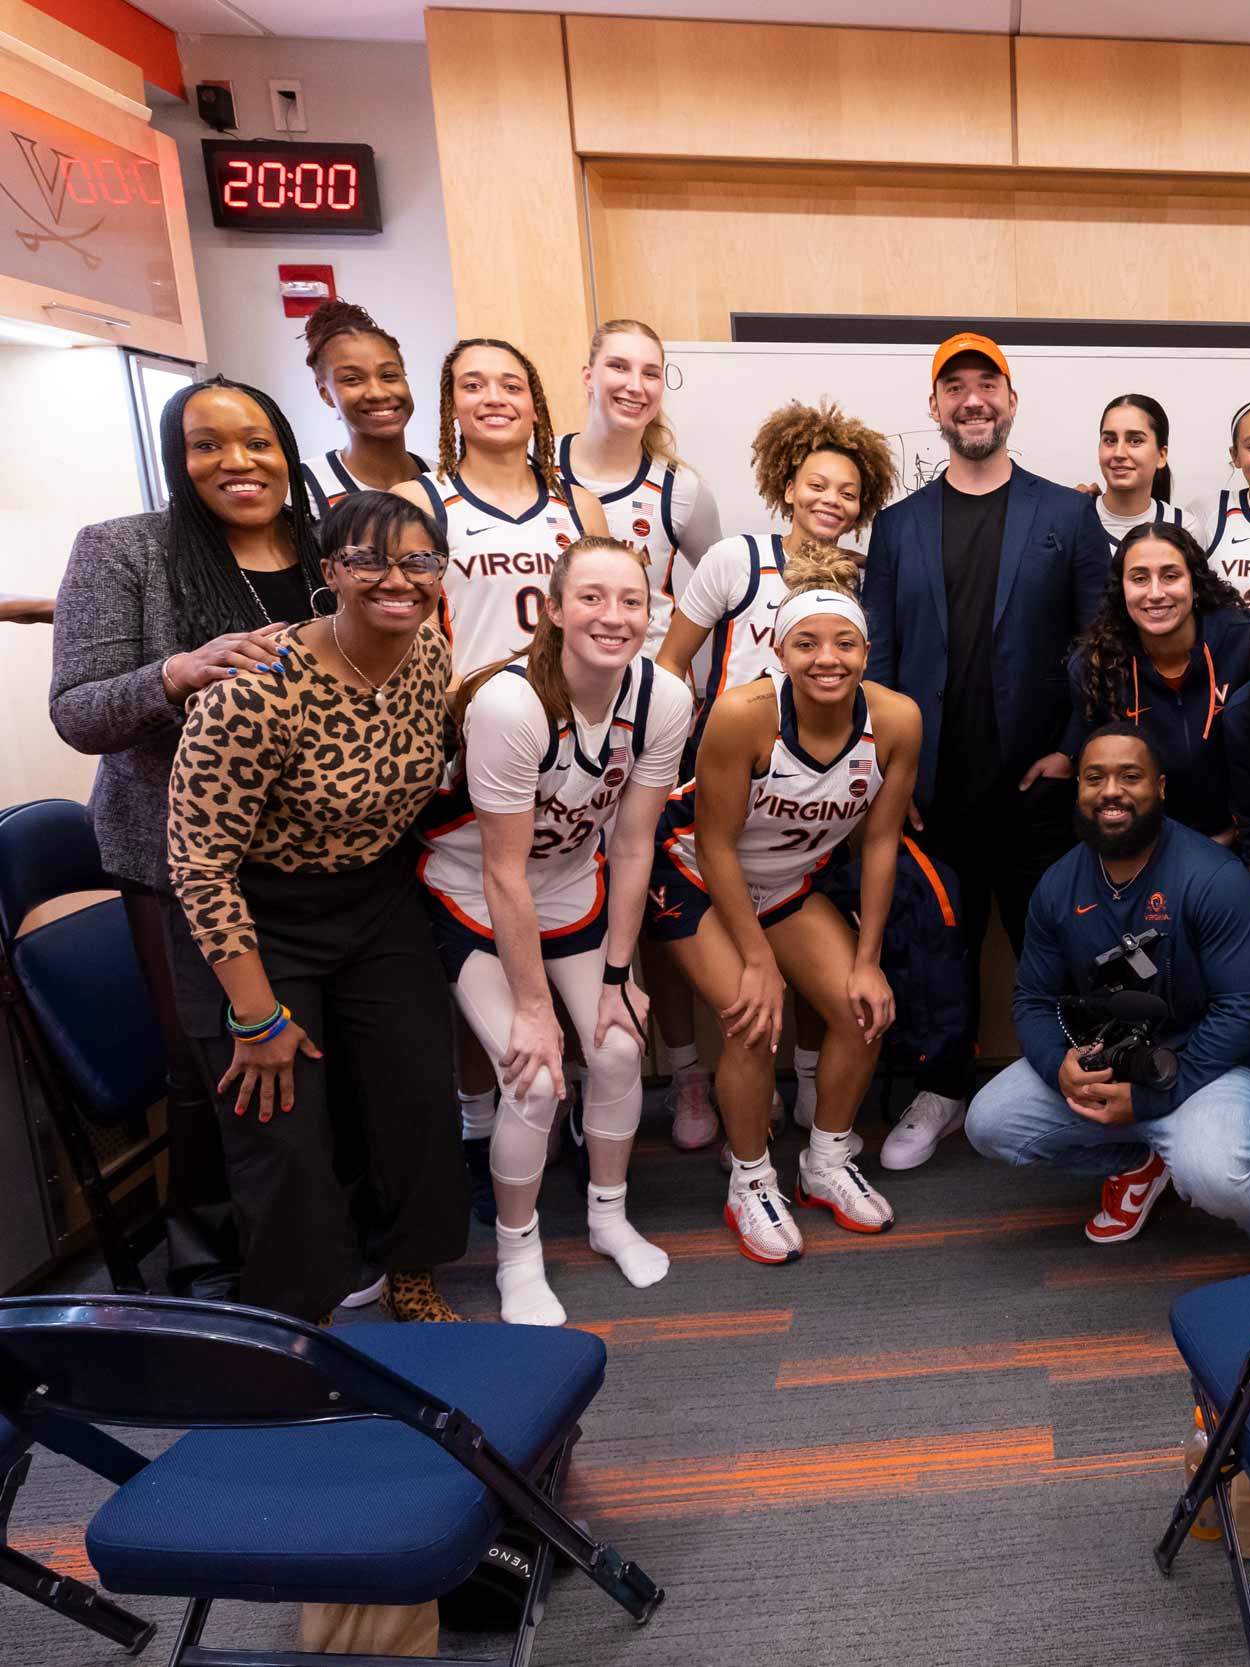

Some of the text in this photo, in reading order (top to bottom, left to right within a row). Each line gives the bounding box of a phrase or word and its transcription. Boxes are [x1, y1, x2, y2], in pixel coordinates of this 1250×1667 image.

[224, 161, 356, 210] 20:00
[753, 786, 869, 821] VIRGINIA
[768, 829, 829, 852] 21
